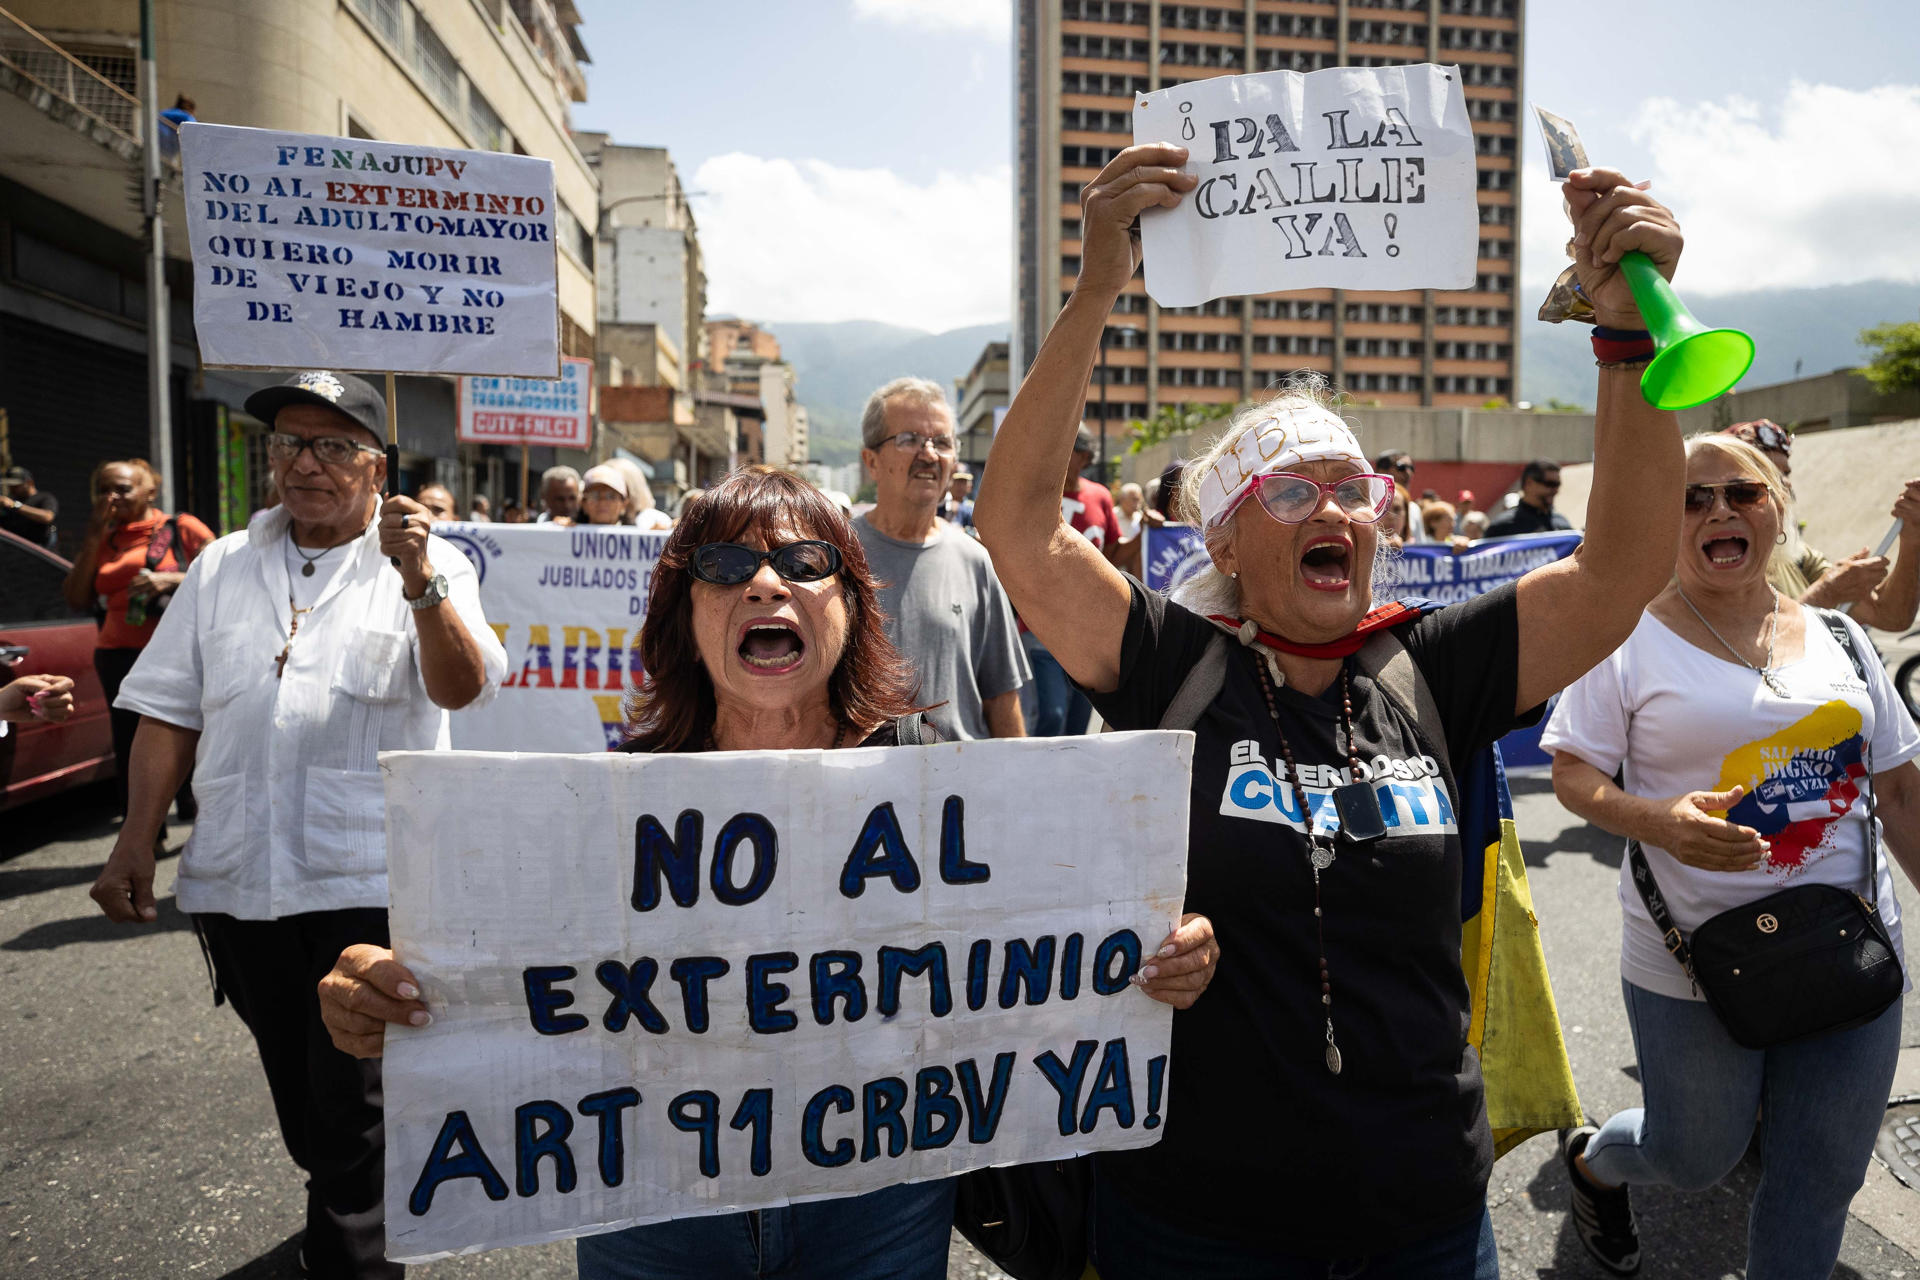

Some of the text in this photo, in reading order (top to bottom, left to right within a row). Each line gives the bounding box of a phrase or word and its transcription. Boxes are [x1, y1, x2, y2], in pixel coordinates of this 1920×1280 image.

[1322, 107, 1423, 151] LA
[277, 145, 467, 180] FENAJUPV
[203, 171, 545, 216] NO AL EXTERMINIO
[1194, 157, 1426, 219] CALLE
[206, 200, 279, 226] DEL
[208, 235, 503, 276] QUIERO MORIR
[211, 265, 505, 309] DE VIEJO Y NO
[247, 301, 496, 336] DE HAMBRE
[505, 378, 549, 393] TODOS
[553, 380, 579, 396] LOS
[571, 531, 632, 560] UNION
[538, 564, 638, 591] JUBILADOS
[1434, 555, 1454, 583] DE
[1230, 739, 1268, 766] EL
[1760, 745, 1837, 762] SALARIO
[1762, 759, 1833, 780] DIGNO
[630, 794, 992, 913] NO AL
[523, 927, 1145, 1036] EXTERMINIO
[409, 1036, 1168, 1217] ART 91 CRBV YA!
